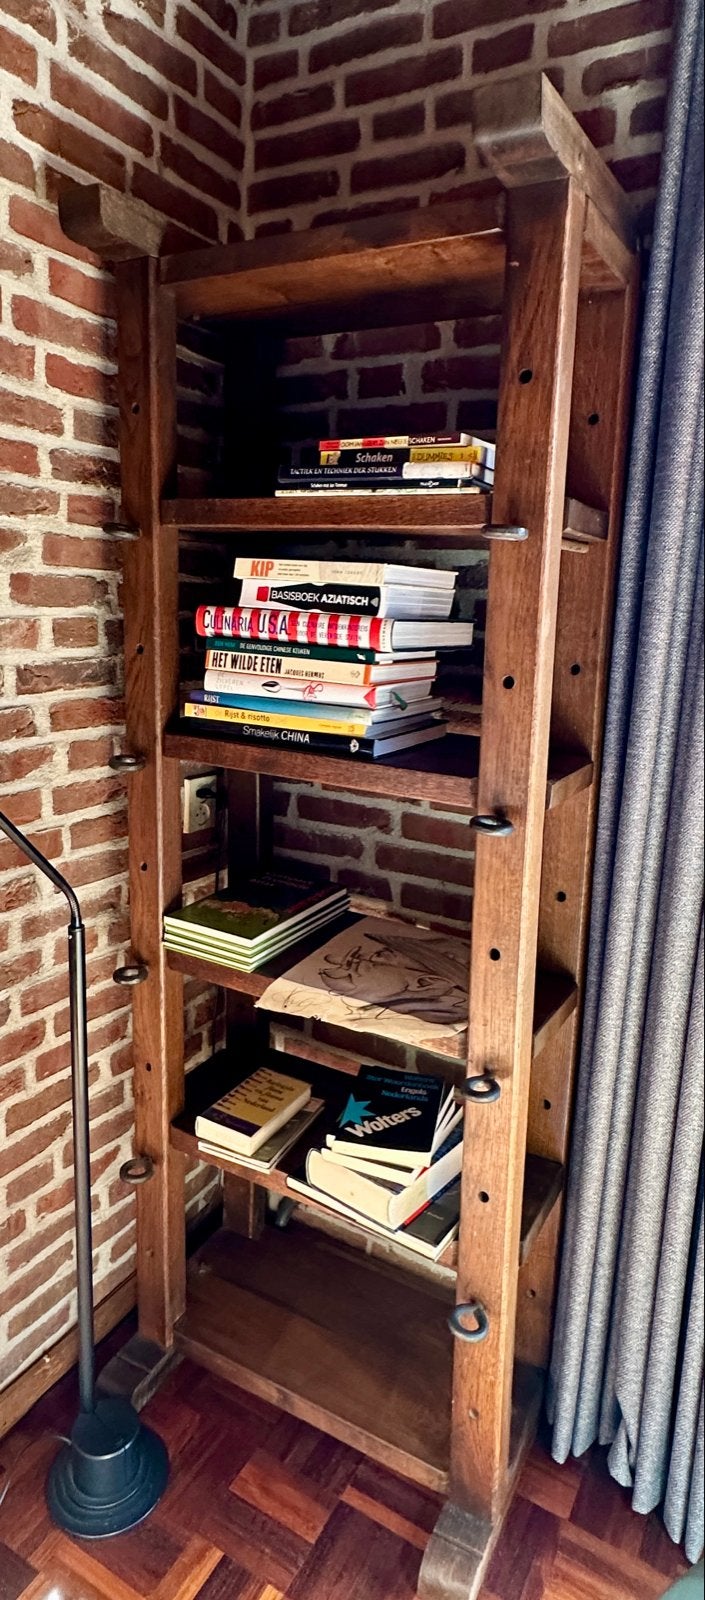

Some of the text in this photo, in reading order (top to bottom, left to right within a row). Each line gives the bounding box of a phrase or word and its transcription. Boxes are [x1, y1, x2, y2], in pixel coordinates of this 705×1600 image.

[356, 452, 393, 462] Schaken
[250, 560, 274, 577] KIP
[271, 590, 368, 606] BASISBOEK AZIATISCH
[212, 652, 282, 674] HET WILDE ETEN
[204, 694, 220, 703] RIJST
[225, 710, 239, 719] Rijst
[248, 714, 270, 722] risotto
[243, 726, 310, 744] Smakelijk CHINA
[381, 1090, 428, 1102] Nederlands
[401, 1086, 427, 1095] Engels
[344, 1107, 422, 1138] Wolters
